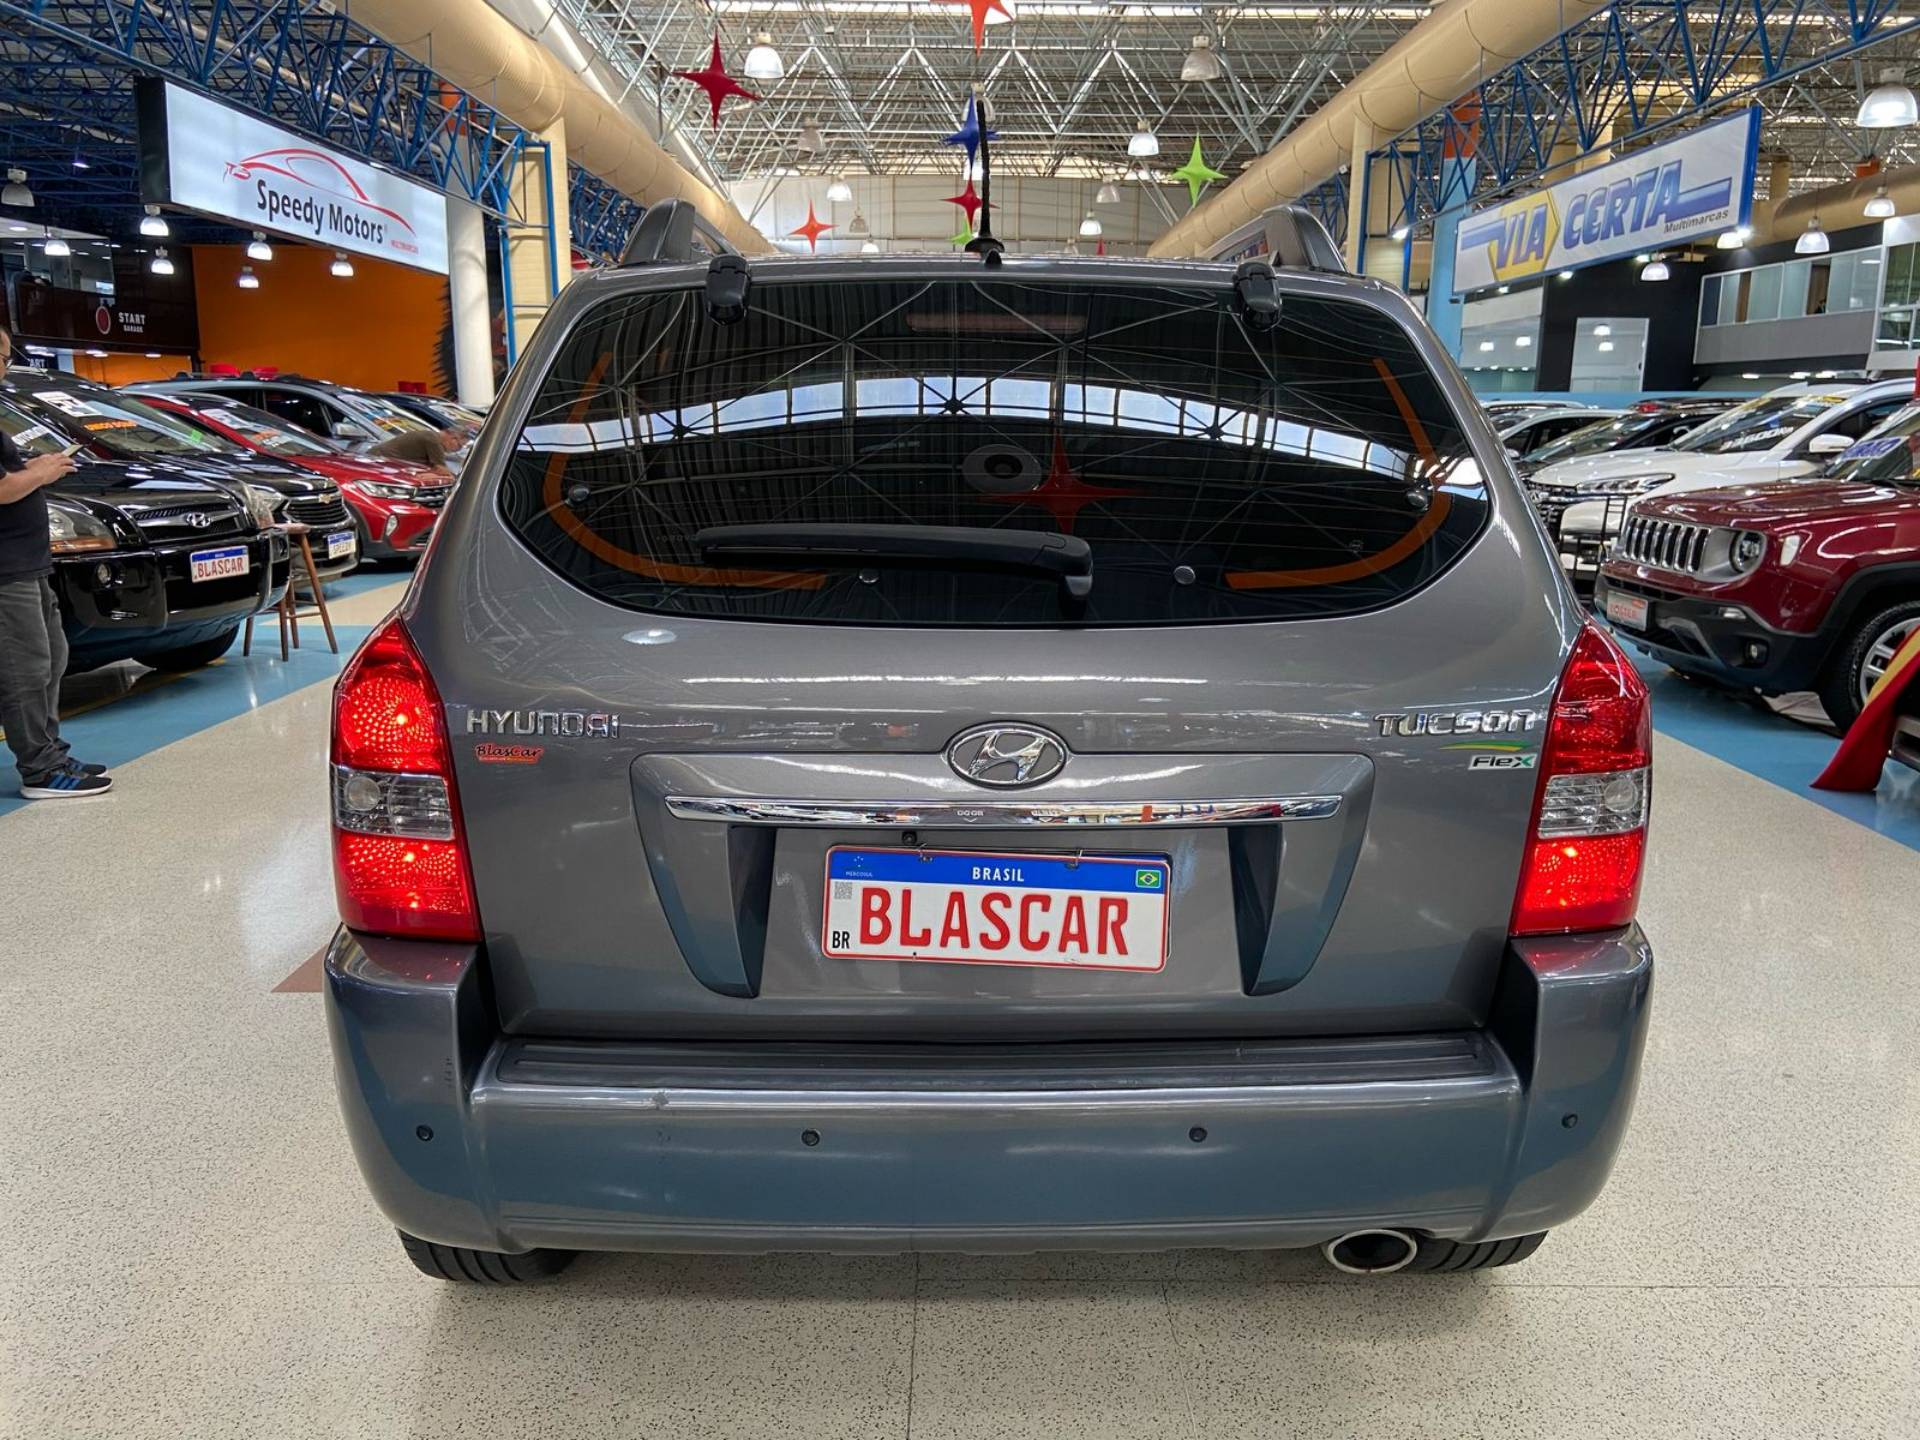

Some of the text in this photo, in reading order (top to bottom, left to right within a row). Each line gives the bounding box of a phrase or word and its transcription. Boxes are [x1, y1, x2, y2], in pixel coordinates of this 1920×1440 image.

[256, 179, 383, 244] Speedy Motors
[1495, 159, 1683, 270] VIA CERTA
[1663, 209, 1729, 234] Multimarcas
[118, 311, 146, 325] START
[197, 557, 244, 578] BLASCAR
[466, 709, 620, 738] HYUNDAI
[1374, 708, 1537, 737] TUCSON
[971, 866, 1025, 882] BRASIL
[860, 887, 1129, 956] BLASCAR
[831, 930, 851, 949] BR
